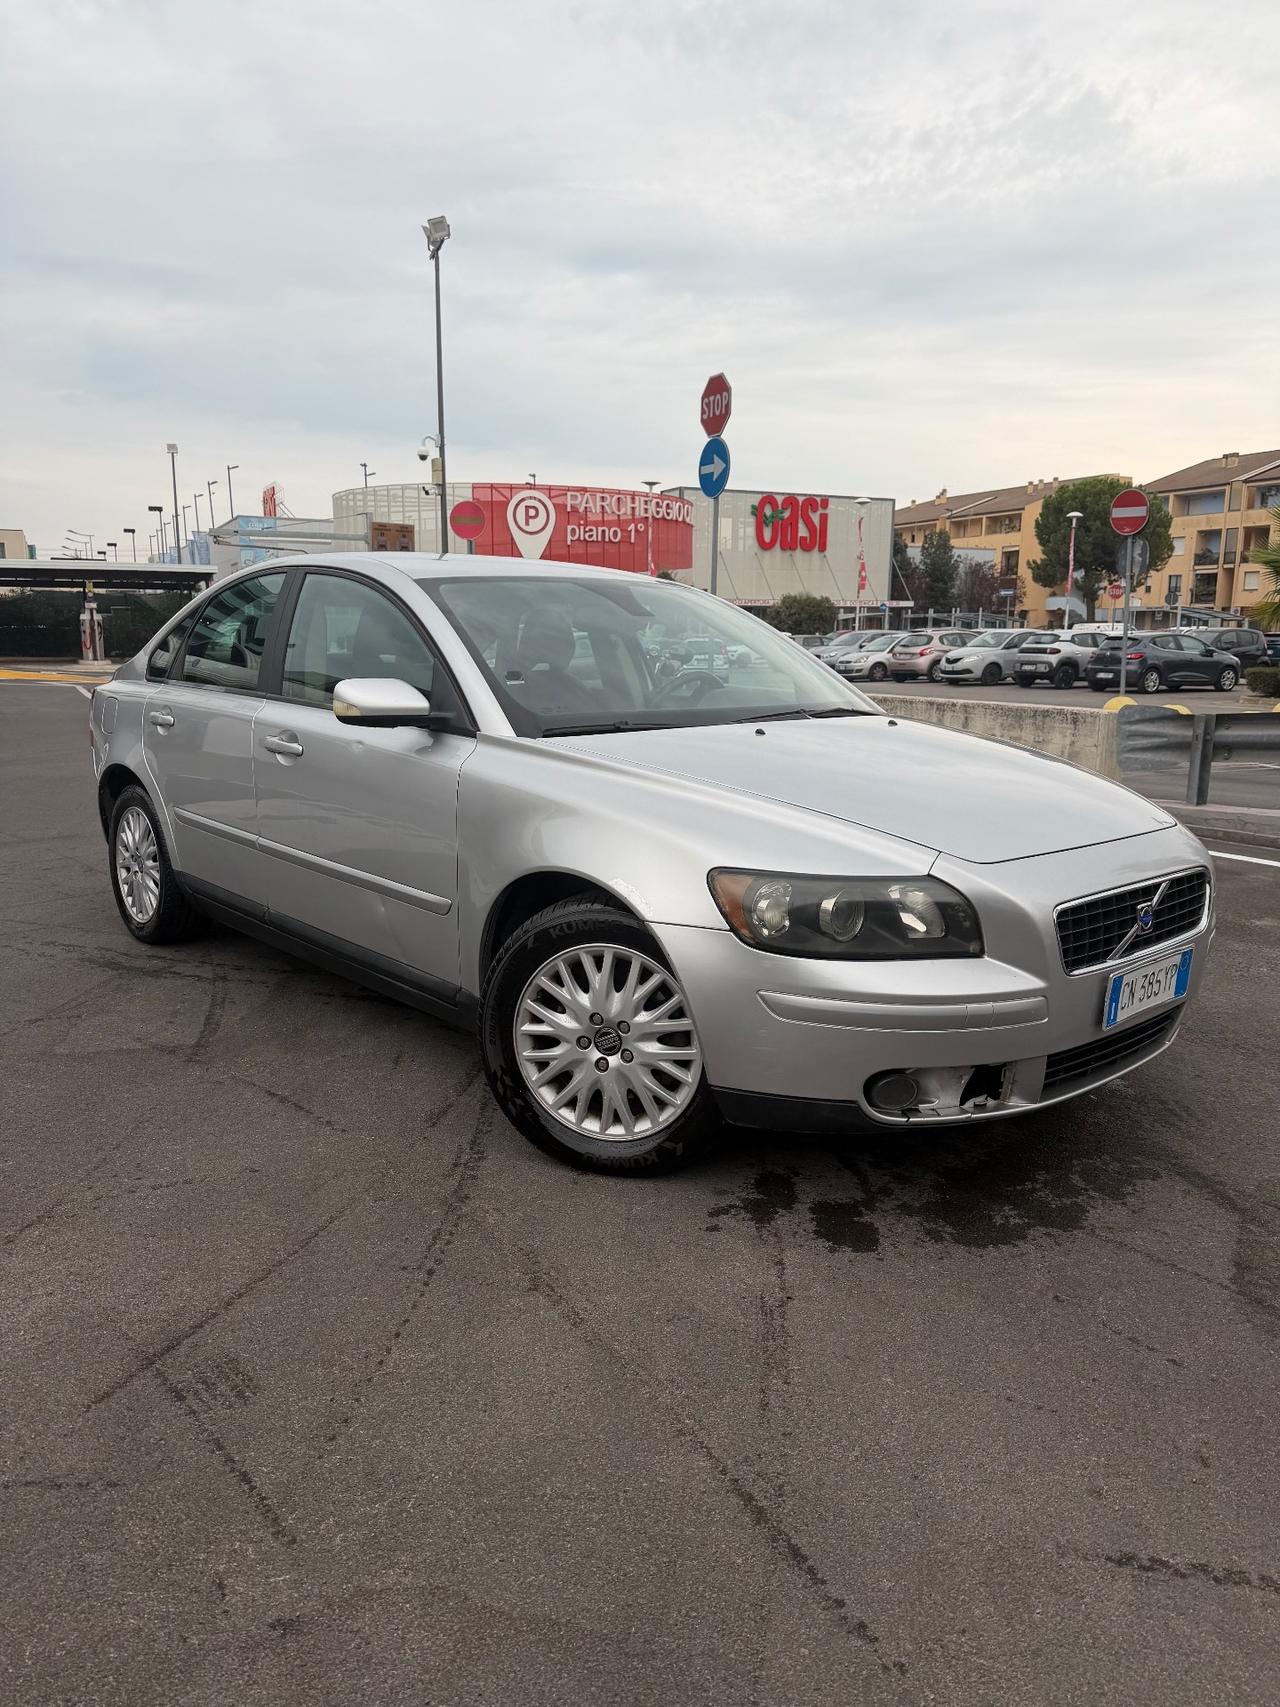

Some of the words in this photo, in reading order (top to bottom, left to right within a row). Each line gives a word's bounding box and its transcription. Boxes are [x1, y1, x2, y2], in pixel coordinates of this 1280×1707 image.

[702, 391, 729, 420] STOP
[524, 505, 540, 527] P
[567, 491, 684, 522] PARCHEGGIO
[567, 520, 621, 545] piano
[1120, 977, 1138, 1010] CN
